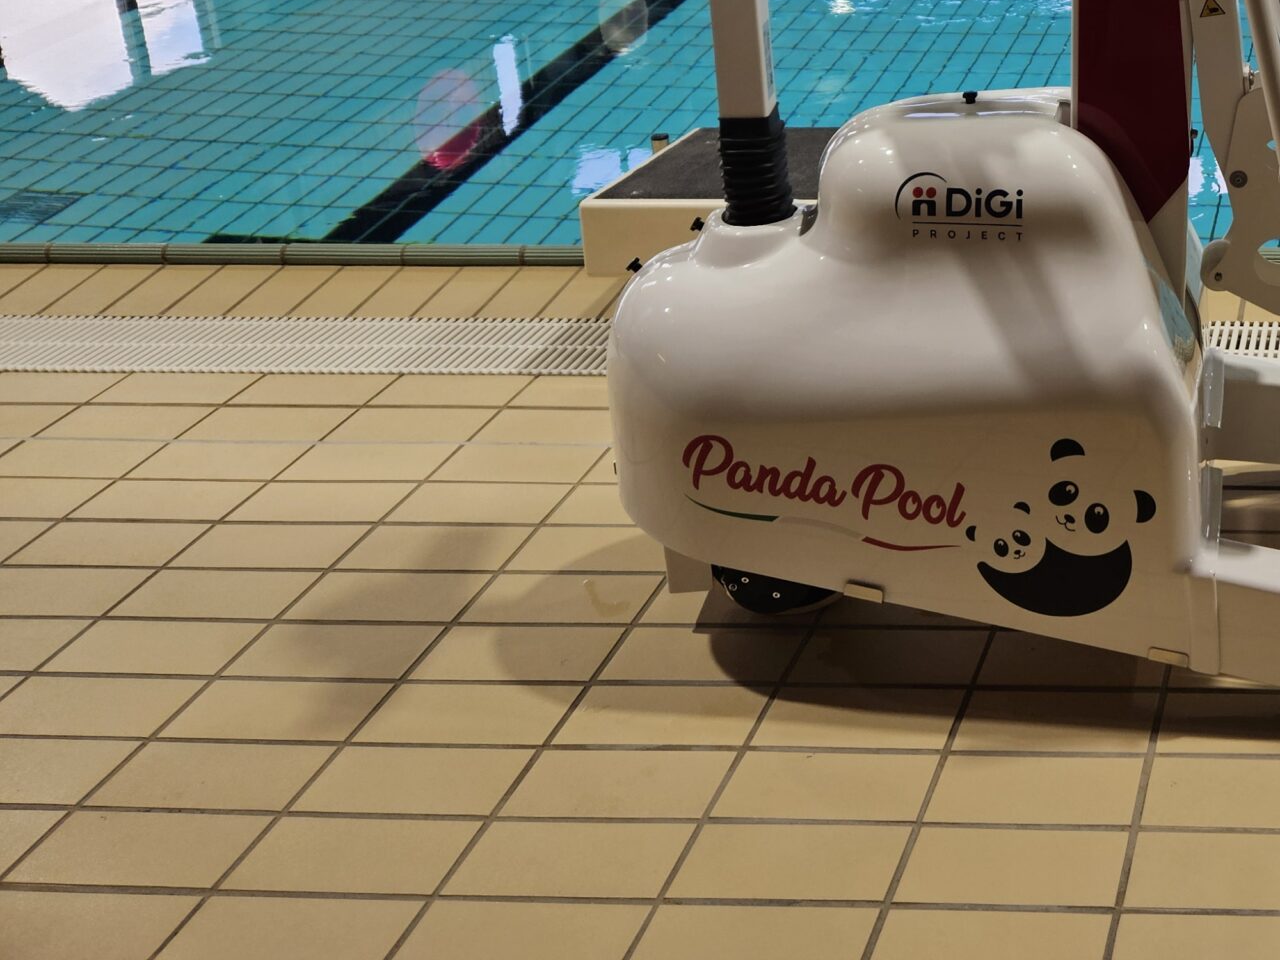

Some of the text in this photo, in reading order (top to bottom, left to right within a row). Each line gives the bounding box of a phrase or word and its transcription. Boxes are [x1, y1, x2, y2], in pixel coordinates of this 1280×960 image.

[946, 187, 1024, 219] DiGi
[912, 229, 1023, 241] PROJECT
[682, 434, 967, 528] Panda Pool
